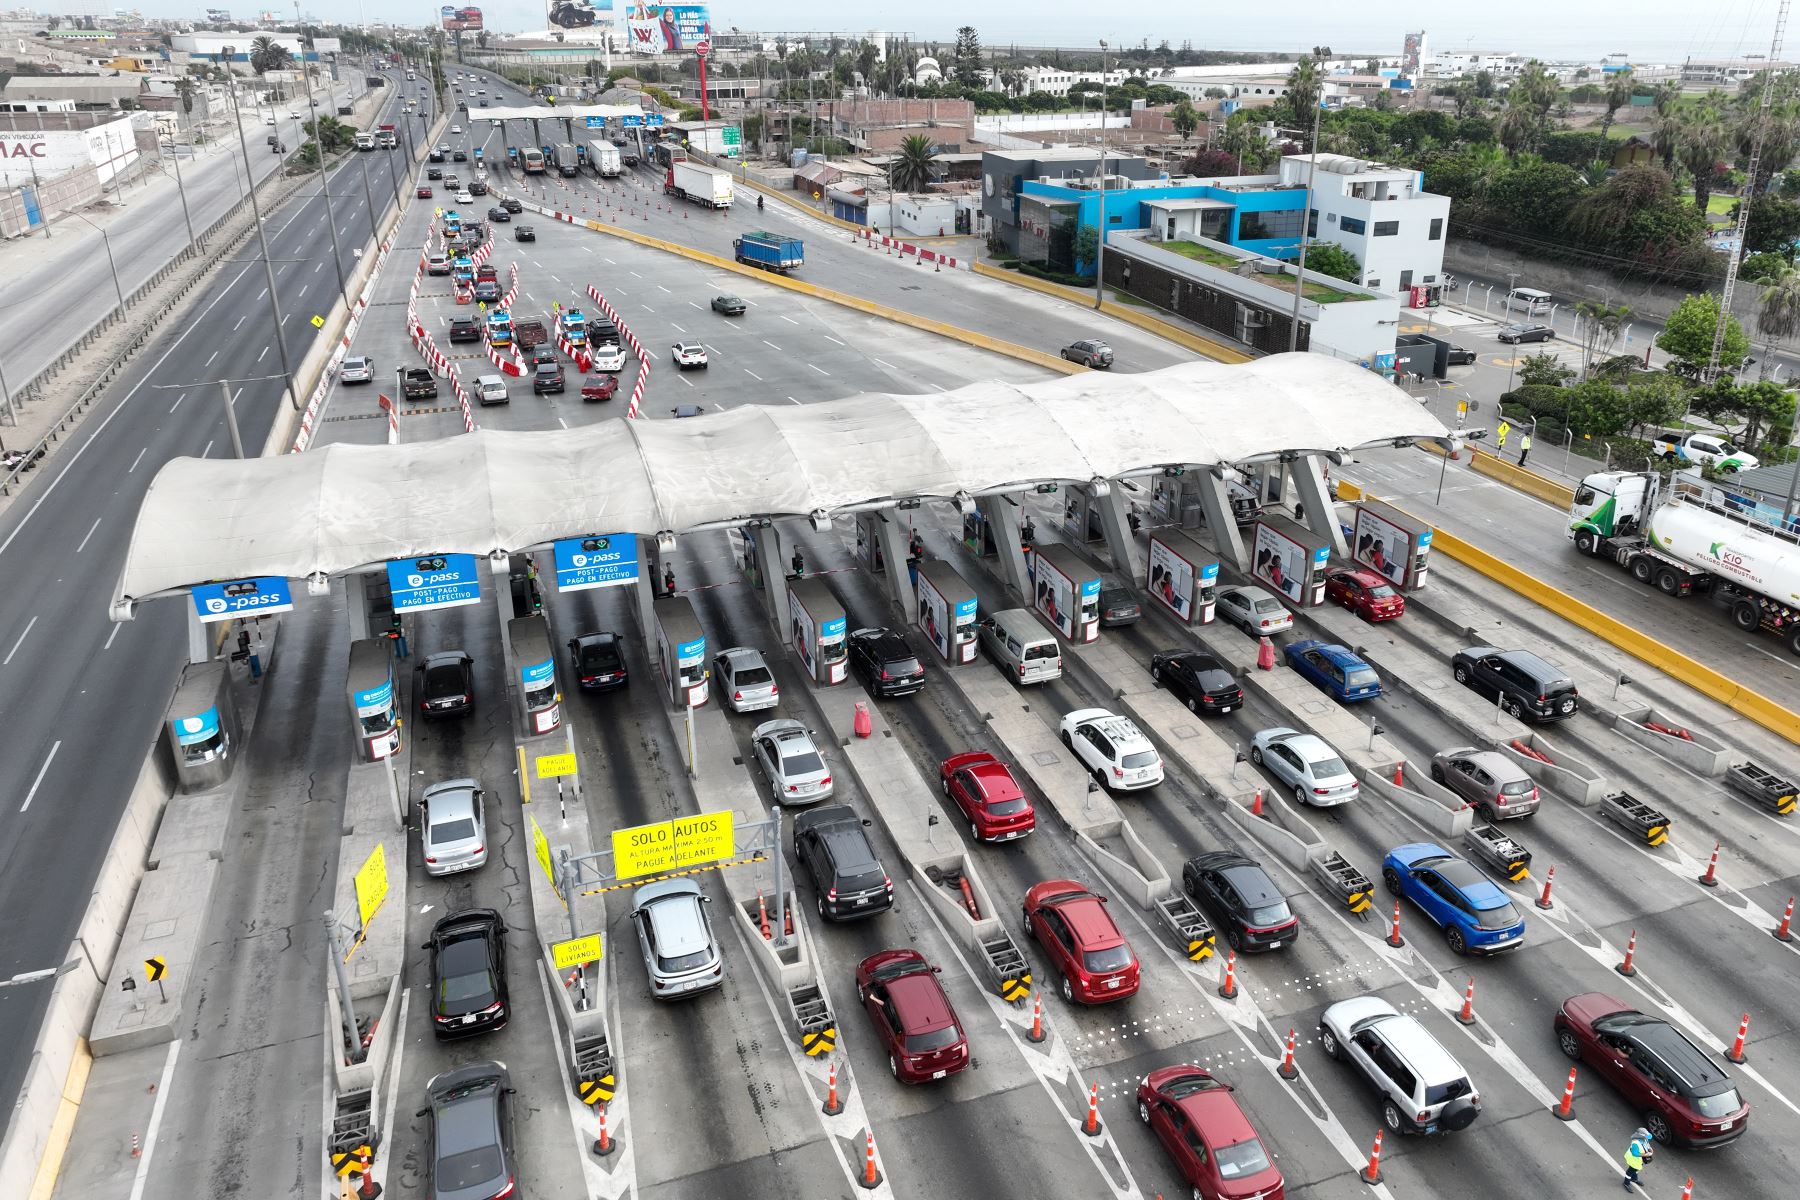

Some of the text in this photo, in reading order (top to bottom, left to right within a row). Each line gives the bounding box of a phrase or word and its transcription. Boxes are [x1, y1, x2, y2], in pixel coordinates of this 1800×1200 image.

[572, 551, 621, 568] e-pass
[1723, 552, 1743, 565] KIO
[577, 566, 619, 577] POST-PAGO
[1696, 552, 1763, 583] PELIGRO COMBUSTIBLE
[407, 571, 460, 587] e-pass
[566, 577, 585, 585] PAGO
[599, 571, 630, 581] EFECTIVO
[402, 598, 422, 606] PAGO
[437, 591, 471, 601] EFECTIVO
[413, 586, 458, 597] POST-PAGO
[206, 593, 280, 613] e-pass
[631, 820, 718, 847] SOLO AUTOS
[629, 847, 660, 859] ALTURA
[636, 846, 716, 869] PAGUE ADELANTE
[568, 942, 587, 953] SOLO
[561, 949, 596, 963] LIVIANOS
